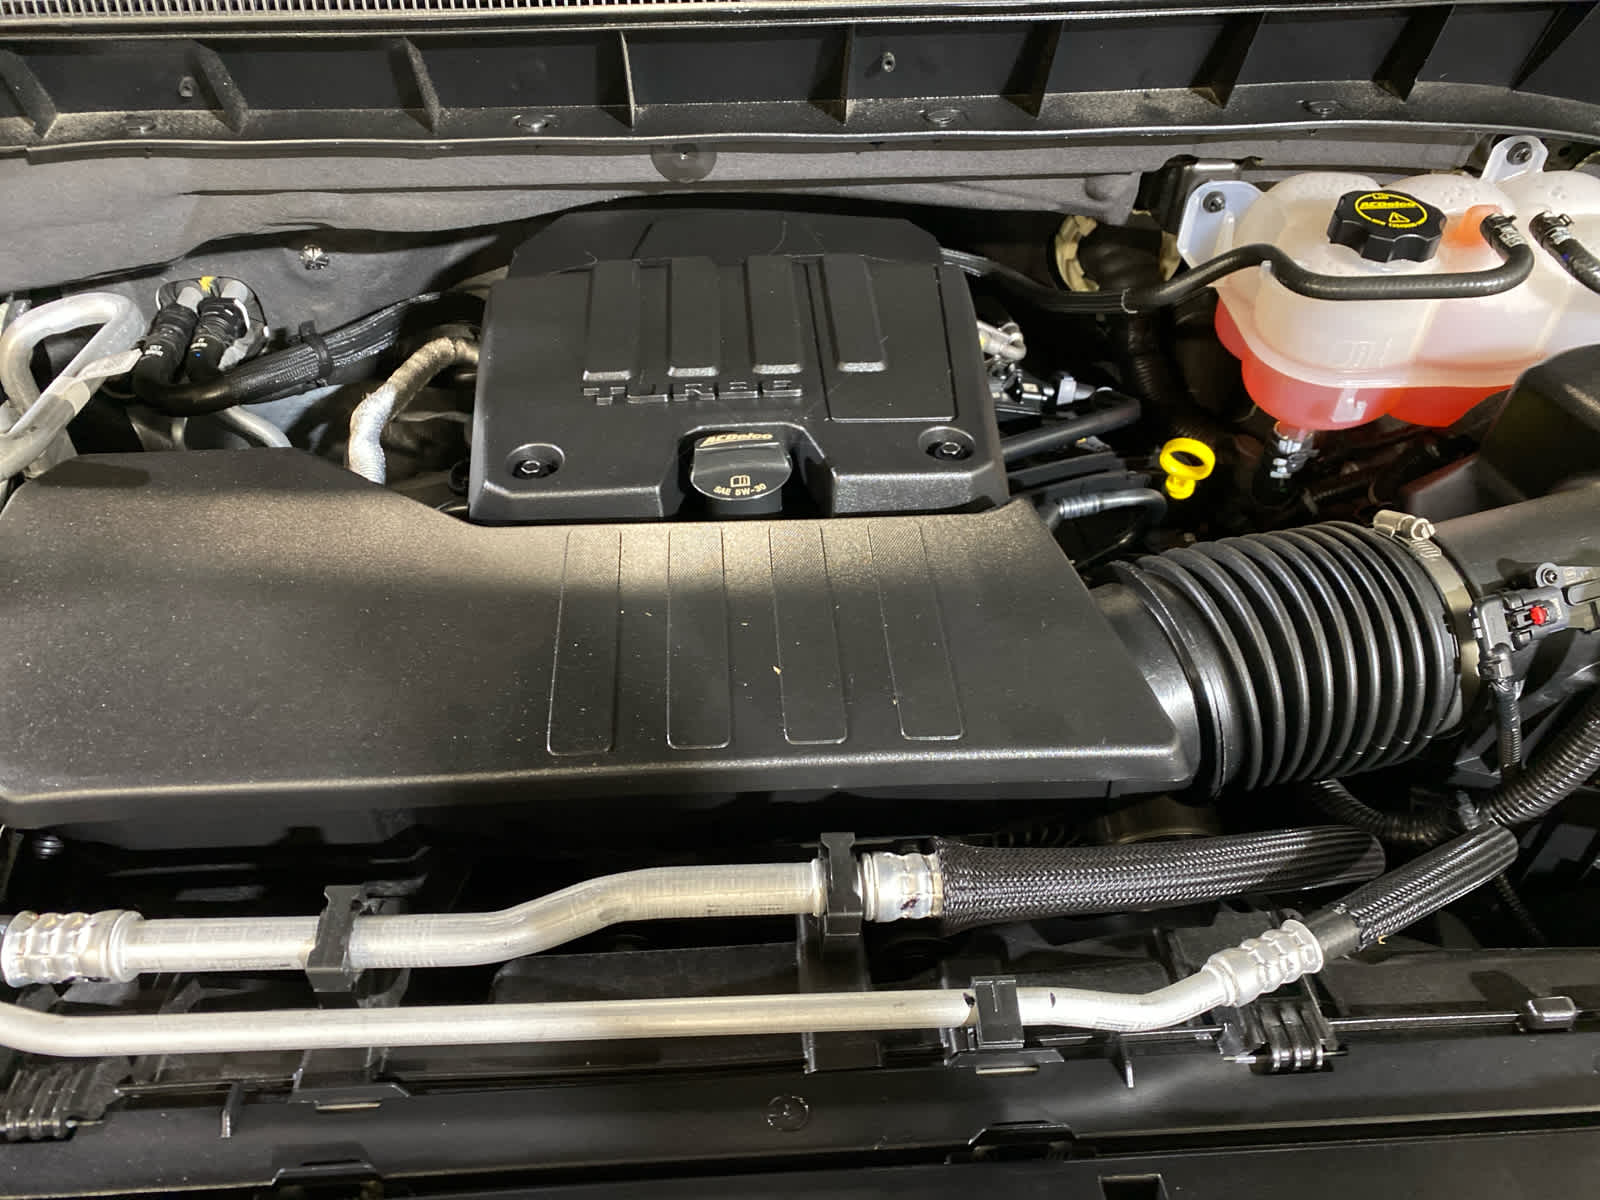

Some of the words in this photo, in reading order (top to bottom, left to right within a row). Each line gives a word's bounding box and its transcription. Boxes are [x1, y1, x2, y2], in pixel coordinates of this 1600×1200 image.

[699, 432, 774, 447] ACDelco
[713, 485, 732, 496] SAE
[735, 483, 767, 496] 5W-30
